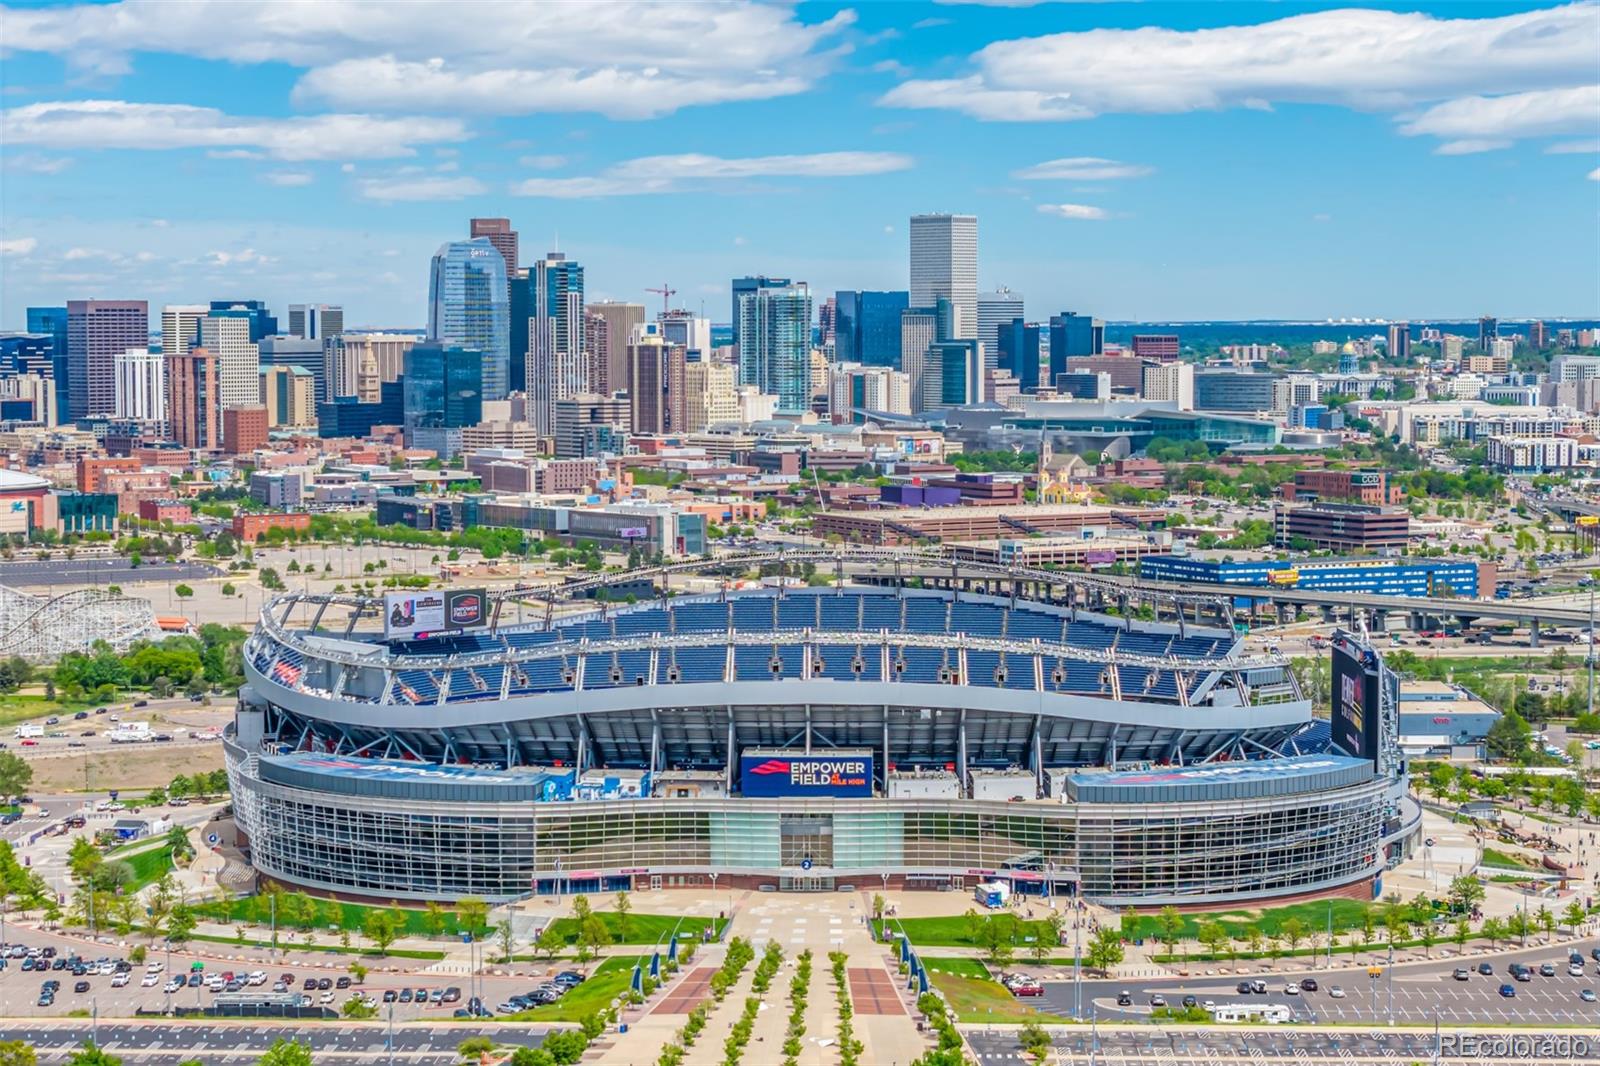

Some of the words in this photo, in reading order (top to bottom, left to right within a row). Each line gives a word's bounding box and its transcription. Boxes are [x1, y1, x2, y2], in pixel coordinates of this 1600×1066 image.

[1361, 475, 1379, 484] CCD
[790, 762, 865, 774] EMPOWER
[790, 774, 831, 785] FIELD
